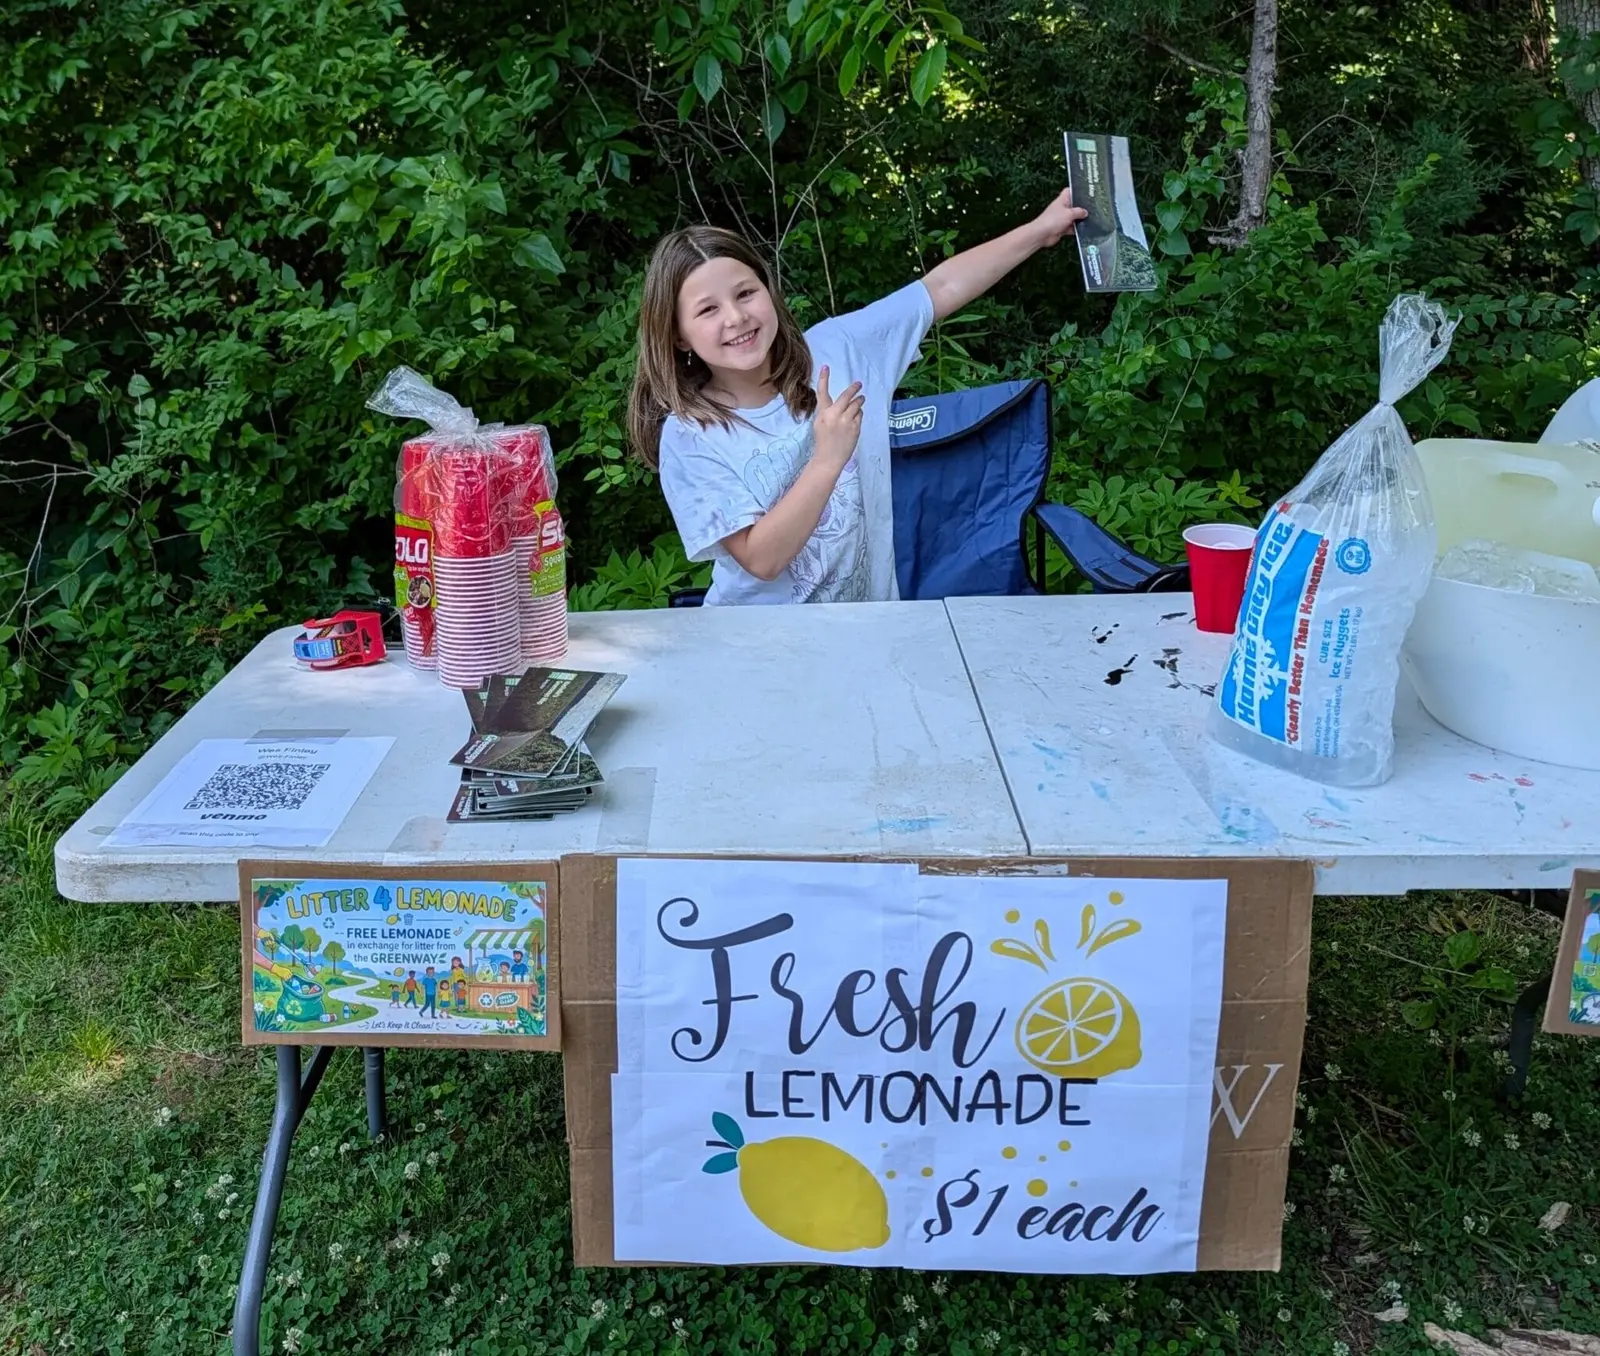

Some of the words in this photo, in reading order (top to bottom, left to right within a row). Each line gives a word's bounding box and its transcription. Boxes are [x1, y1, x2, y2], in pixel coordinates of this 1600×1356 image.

[888, 413, 931, 430] Colema
[395, 536, 428, 564] OLO
[1261, 522, 1293, 572] Ice
[1299, 538, 1330, 615] Homemade
[1246, 573, 1271, 635] City
[1293, 618, 1310, 650] Than
[1323, 619, 1333, 639] SIZE
[1332, 607, 1350, 658] Nuggets
[1319, 641, 1330, 664] CUBE
[1237, 635, 1258, 727] Home
[1288, 653, 1305, 696] Better
[1329, 661, 1342, 679] Ice
[200, 812, 268, 821] venmo
[286, 887, 370, 920] LITTER
[373, 885, 392, 911] 4
[396, 886, 519, 923] LEMONADE
[346, 927, 378, 939] FREE
[381, 928, 451, 939] LEMONADE
[347, 941, 356, 949] in
[358, 941, 400, 952] exchange
[401, 941, 412, 950] for
[414, 941, 435, 950] litter
[436, 942, 456, 950] from
[353, 953, 368, 962] the
[370, 952, 438, 964] GREENWAY
[657, 897, 1006, 1069] Fresh
[371, 1021, 386, 1029] Let's
[387, 1021, 402, 1030] Keep
[411, 1021, 434, 1029] Clean!
[745, 1069, 1099, 1126] LEMONADE
[923, 1169, 1009, 1243] $1
[1016, 1187, 1164, 1243] each
